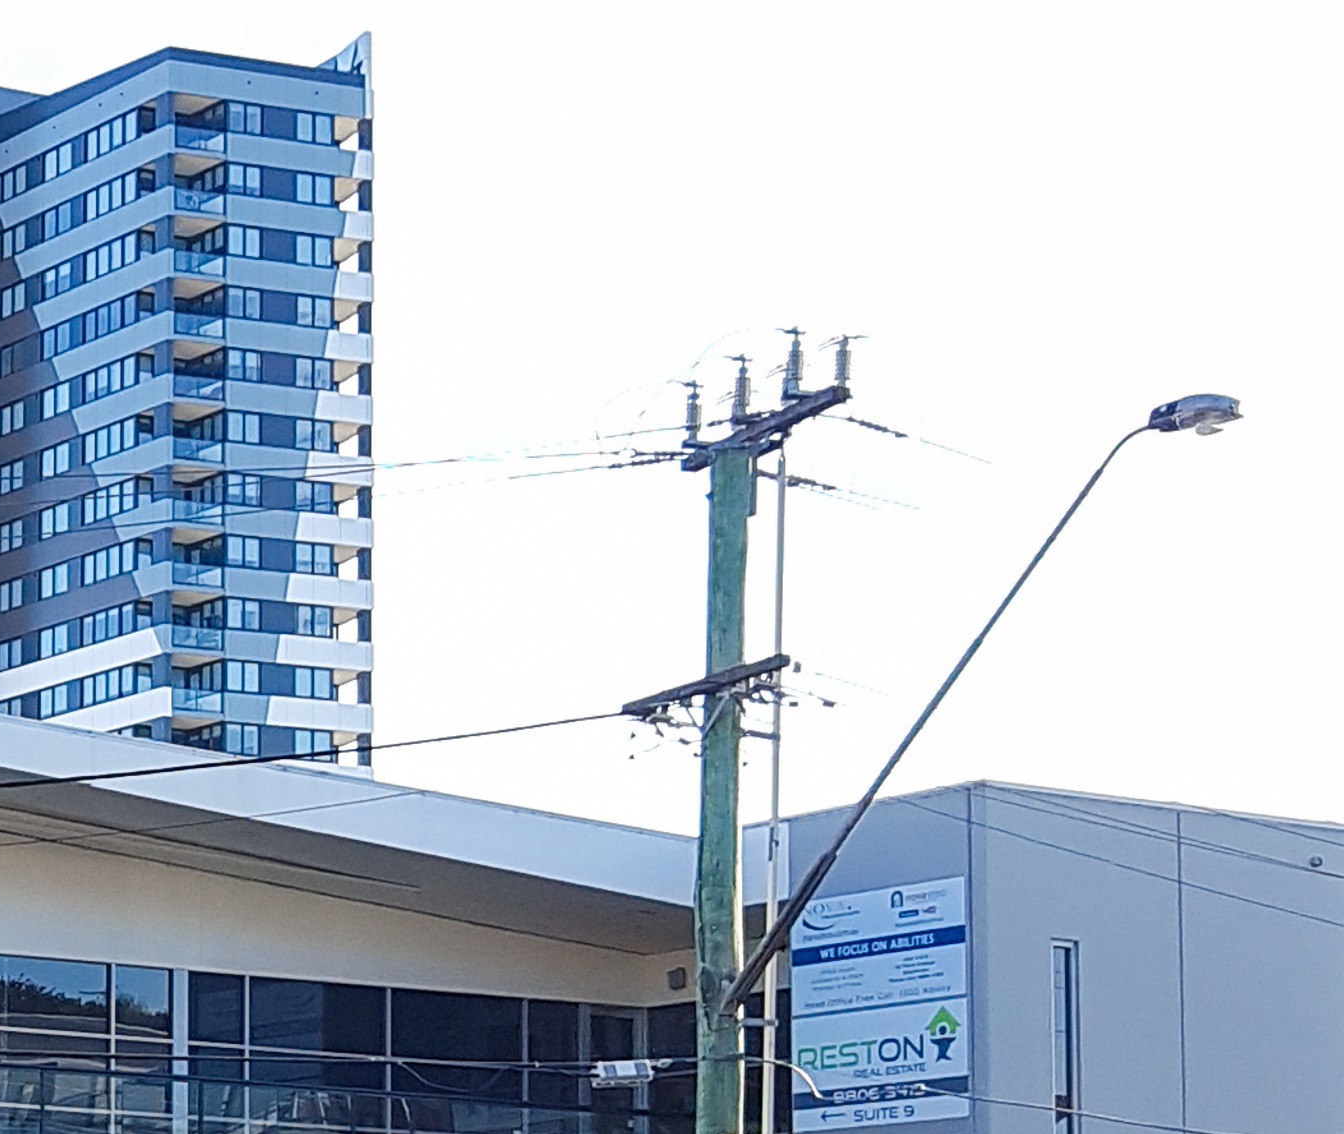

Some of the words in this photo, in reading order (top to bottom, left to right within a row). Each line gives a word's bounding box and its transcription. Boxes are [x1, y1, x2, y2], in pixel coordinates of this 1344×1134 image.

[820, 946, 835, 960] WE
[838, 942, 869, 958] FOCUS
[872, 940, 887, 953] ON
[890, 932, 935, 949] ABILITIES
[797, 1034, 924, 1071] RESTON
[853, 1067, 883, 1078] REAL
[886, 1062, 927, 1076] ESTATE
[853, 1106, 899, 1122] SUITE
[903, 1105, 915, 1117] 9
